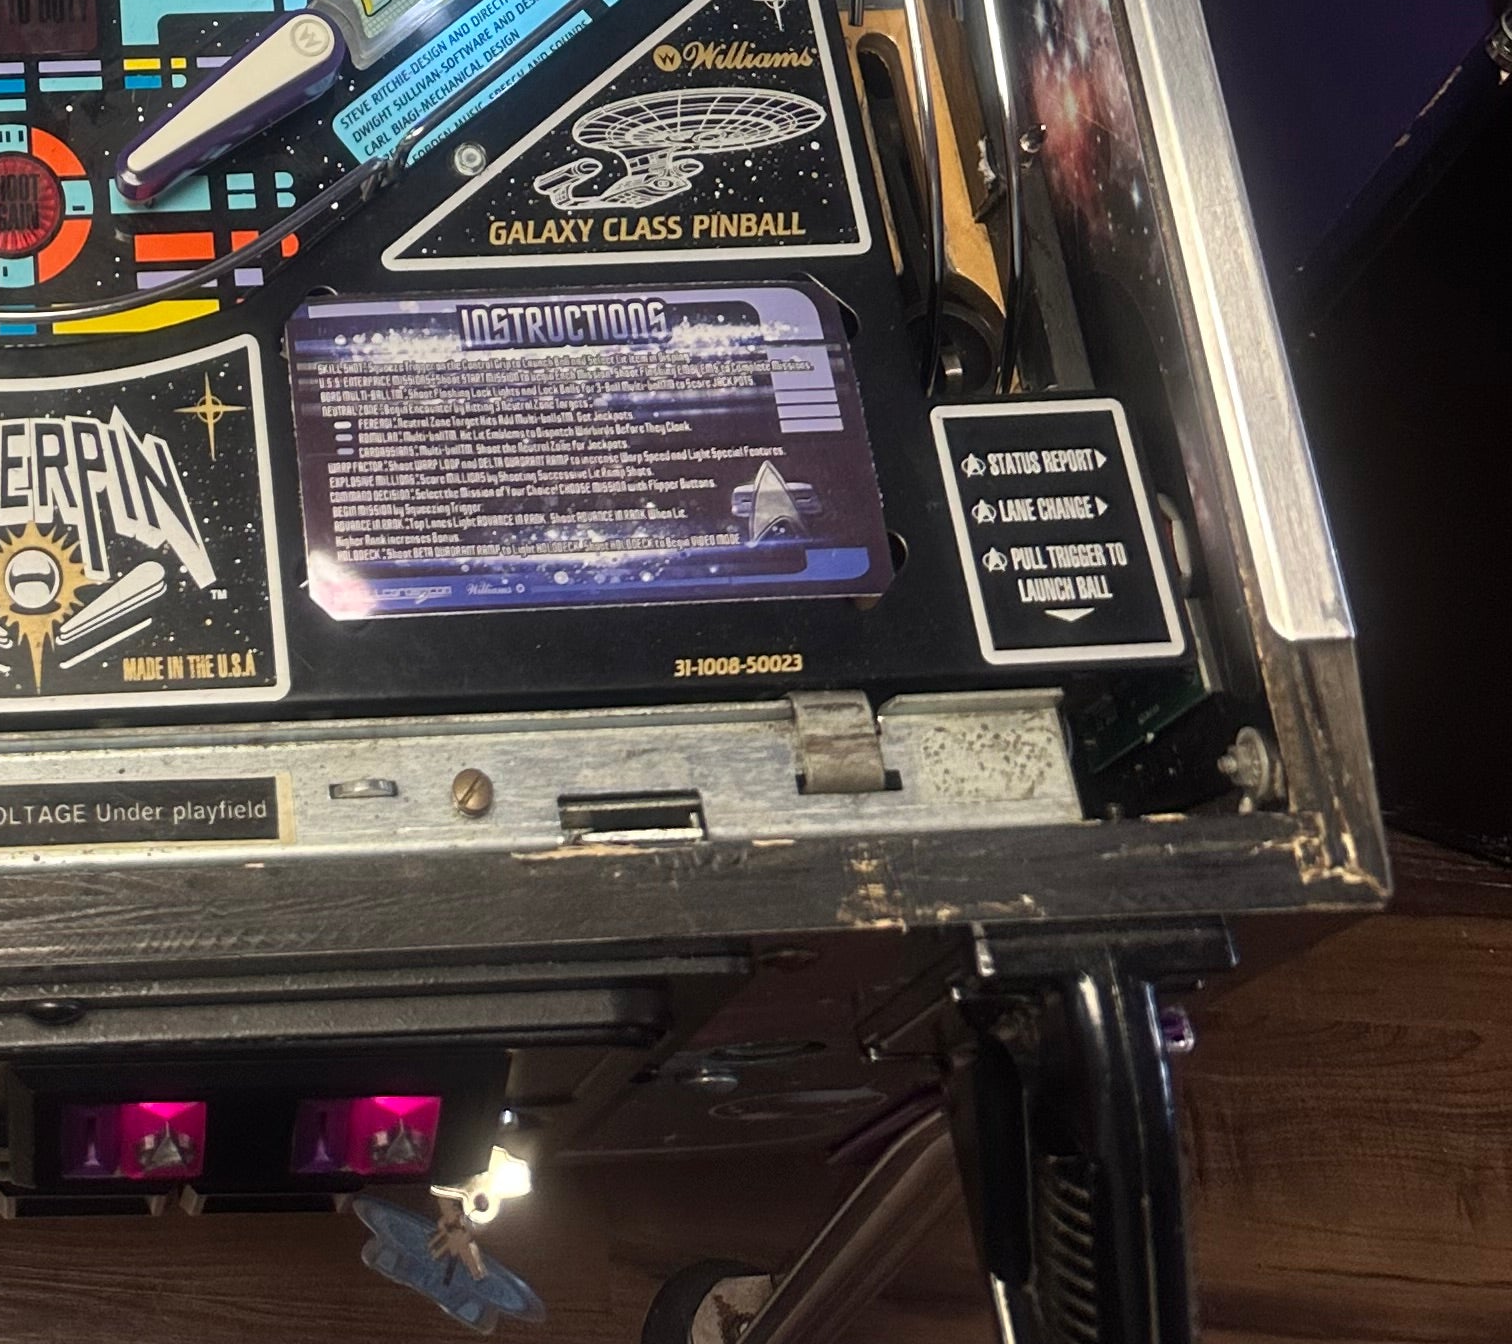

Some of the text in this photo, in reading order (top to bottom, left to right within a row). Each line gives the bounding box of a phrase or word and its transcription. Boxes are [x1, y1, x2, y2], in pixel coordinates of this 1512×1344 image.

[683, 42, 816, 70] Williams
[340, 100, 372, 130] STEVE
[372, 42, 448, 105] RITCHIE-DESIGN
[449, 23, 474, 46] AND
[351, 109, 395, 143] DWIGHT
[394, 30, 492, 112] SULLIVAN-SOFTWARE
[494, 10, 516, 35] AND
[364, 132, 392, 157] CARL
[391, 60, 484, 134] BIAGI-MECHANICAL
[484, 28, 522, 61] DESIGN
[488, 210, 807, 246] GALAXY CLASS PINBALL
[459, 301, 668, 348] INSTRUCTIONS
[985, 448, 1096, 476] STATUS REPORT
[998, 495, 1095, 523] LANE CHANGE
[1011, 543, 1129, 570] PULL TRIGGER TO
[1019, 574, 1114, 602] LAUNCH BALL
[122, 658, 163, 681] MADE
[167, 656, 184, 680] IN
[186, 654, 214, 678] THE
[674, 654, 804, 679] 31-1008-50023
[96, 799, 165, 824] Under
[172, 797, 269, 825] playfield
